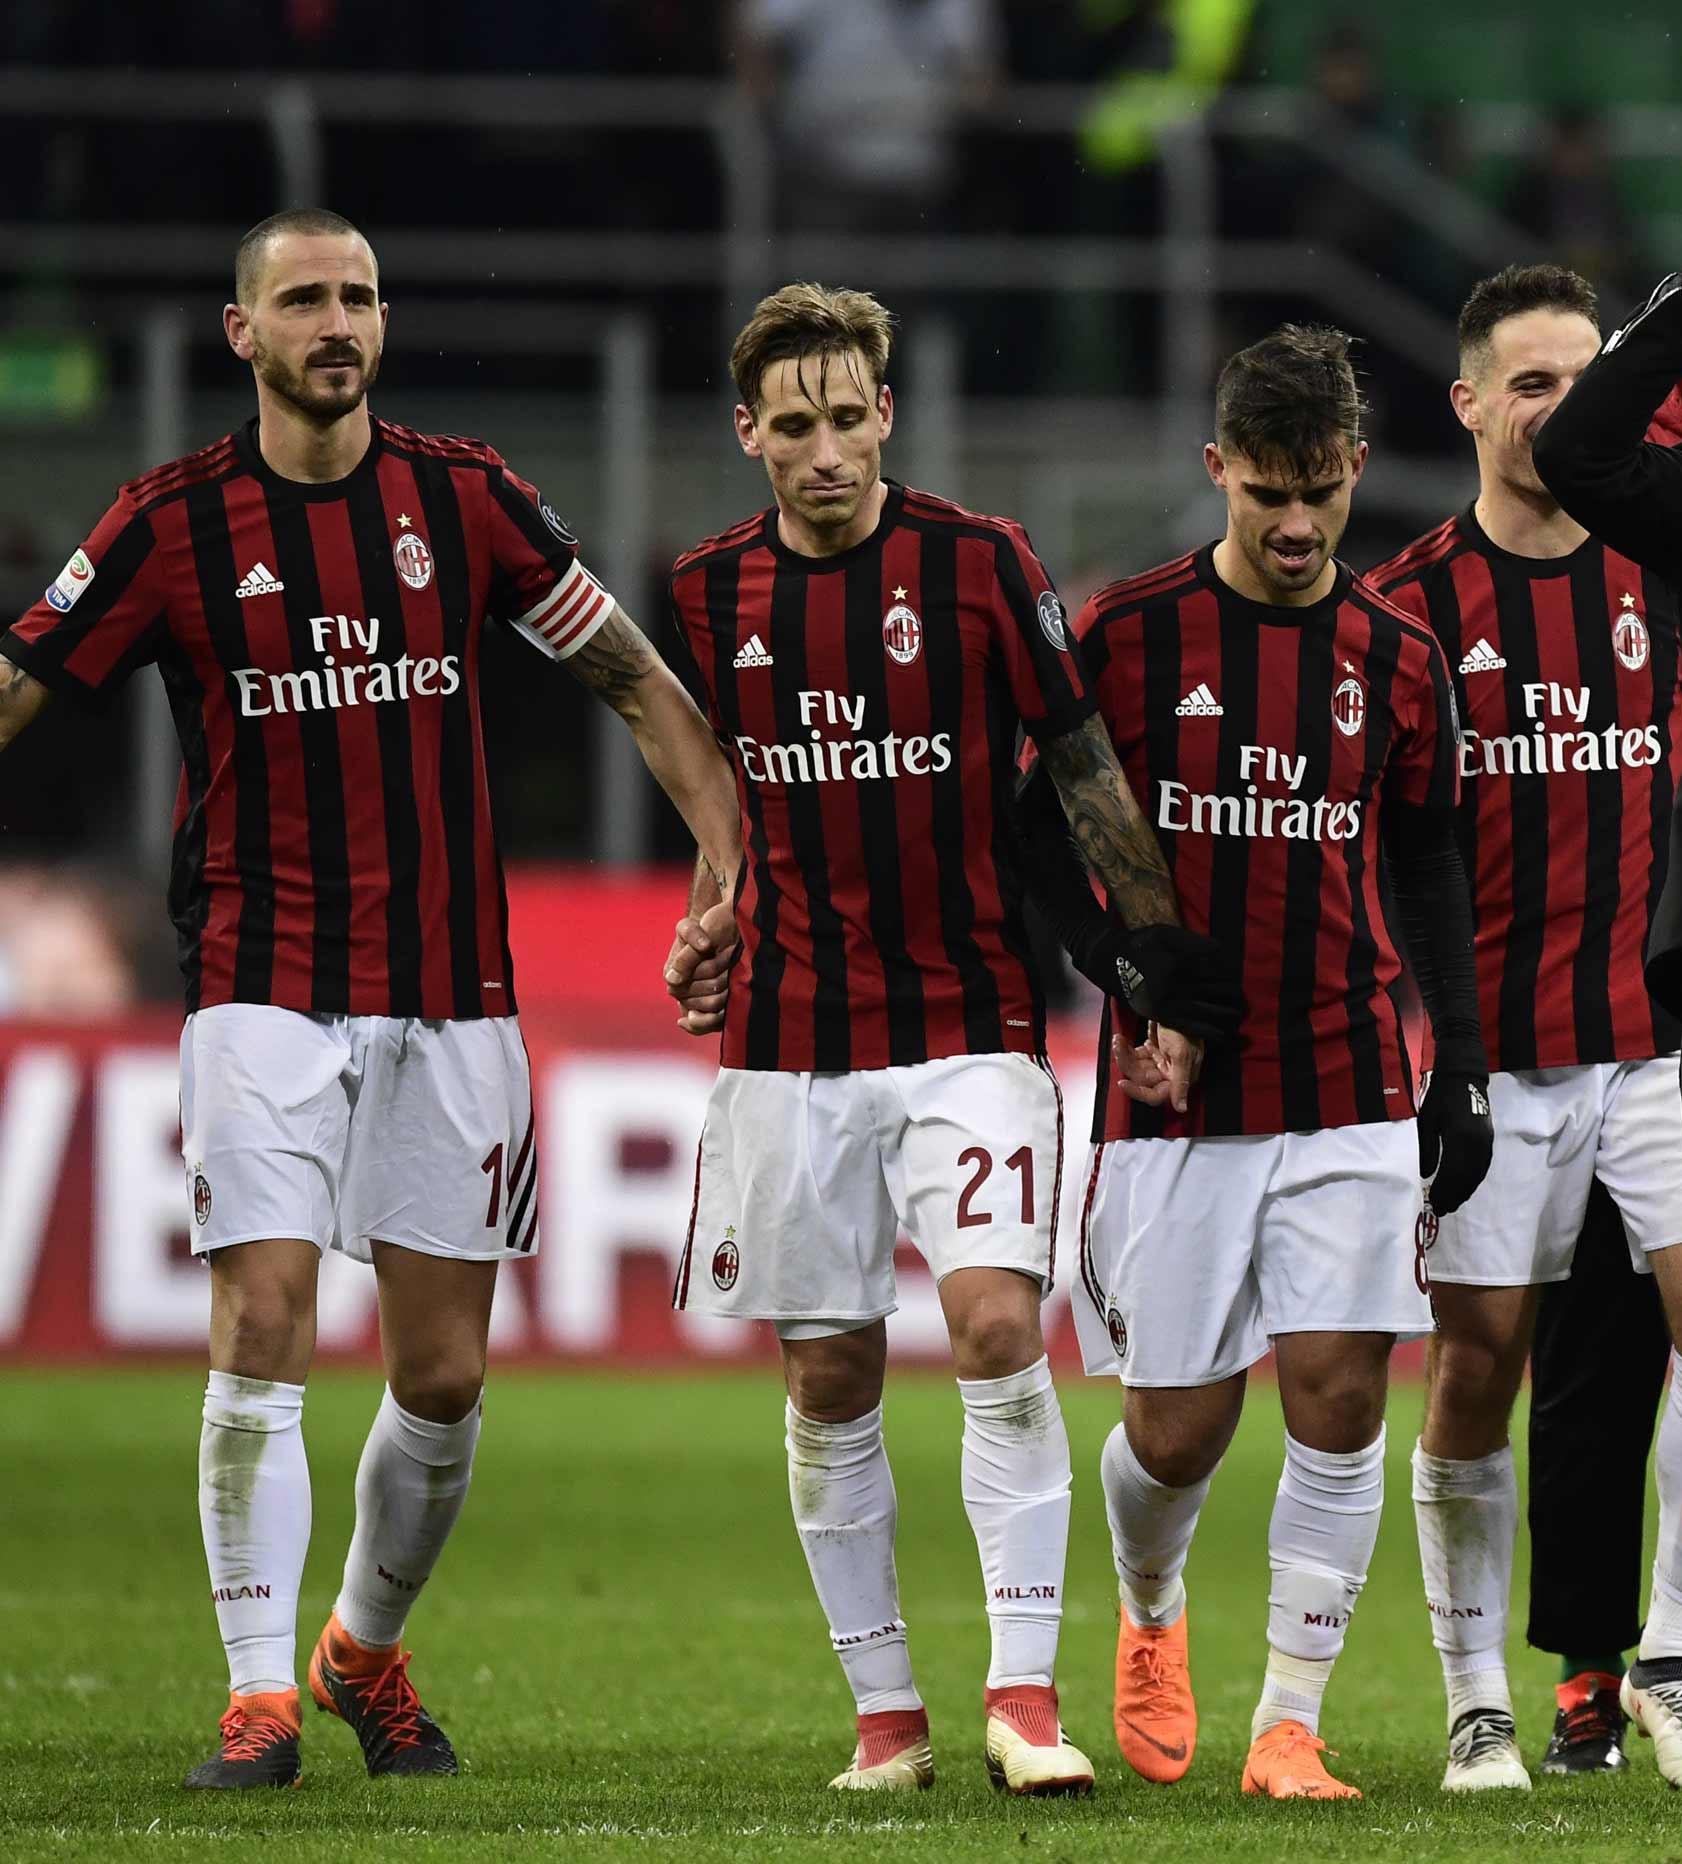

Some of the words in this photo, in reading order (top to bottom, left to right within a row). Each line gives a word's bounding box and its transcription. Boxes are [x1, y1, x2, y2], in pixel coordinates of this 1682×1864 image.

[52, 589, 67, 607] TIM
[236, 580, 285, 598] adidas
[309, 615, 380, 655] Fly
[733, 654, 774, 669] adidas
[1459, 657, 1508, 674] adidas
[233, 653, 460, 717] Emirates
[797, 690, 867, 731] Fly
[1175, 703, 1224, 716] adidas
[1522, 681, 1591, 722] Fly
[735, 730, 952, 784] Emirates
[1459, 722, 1662, 777] Emirates
[1239, 745, 1307, 790] Fly
[1158, 779, 1361, 842] Emirates
[957, 1146, 1035, 1229] 21
[212, 1584, 271, 1602] MILAN
[994, 1585, 1056, 1600] MILAN
[1304, 1612, 1348, 1628] MIL
[1428, 1602, 1485, 1618] MILAN
